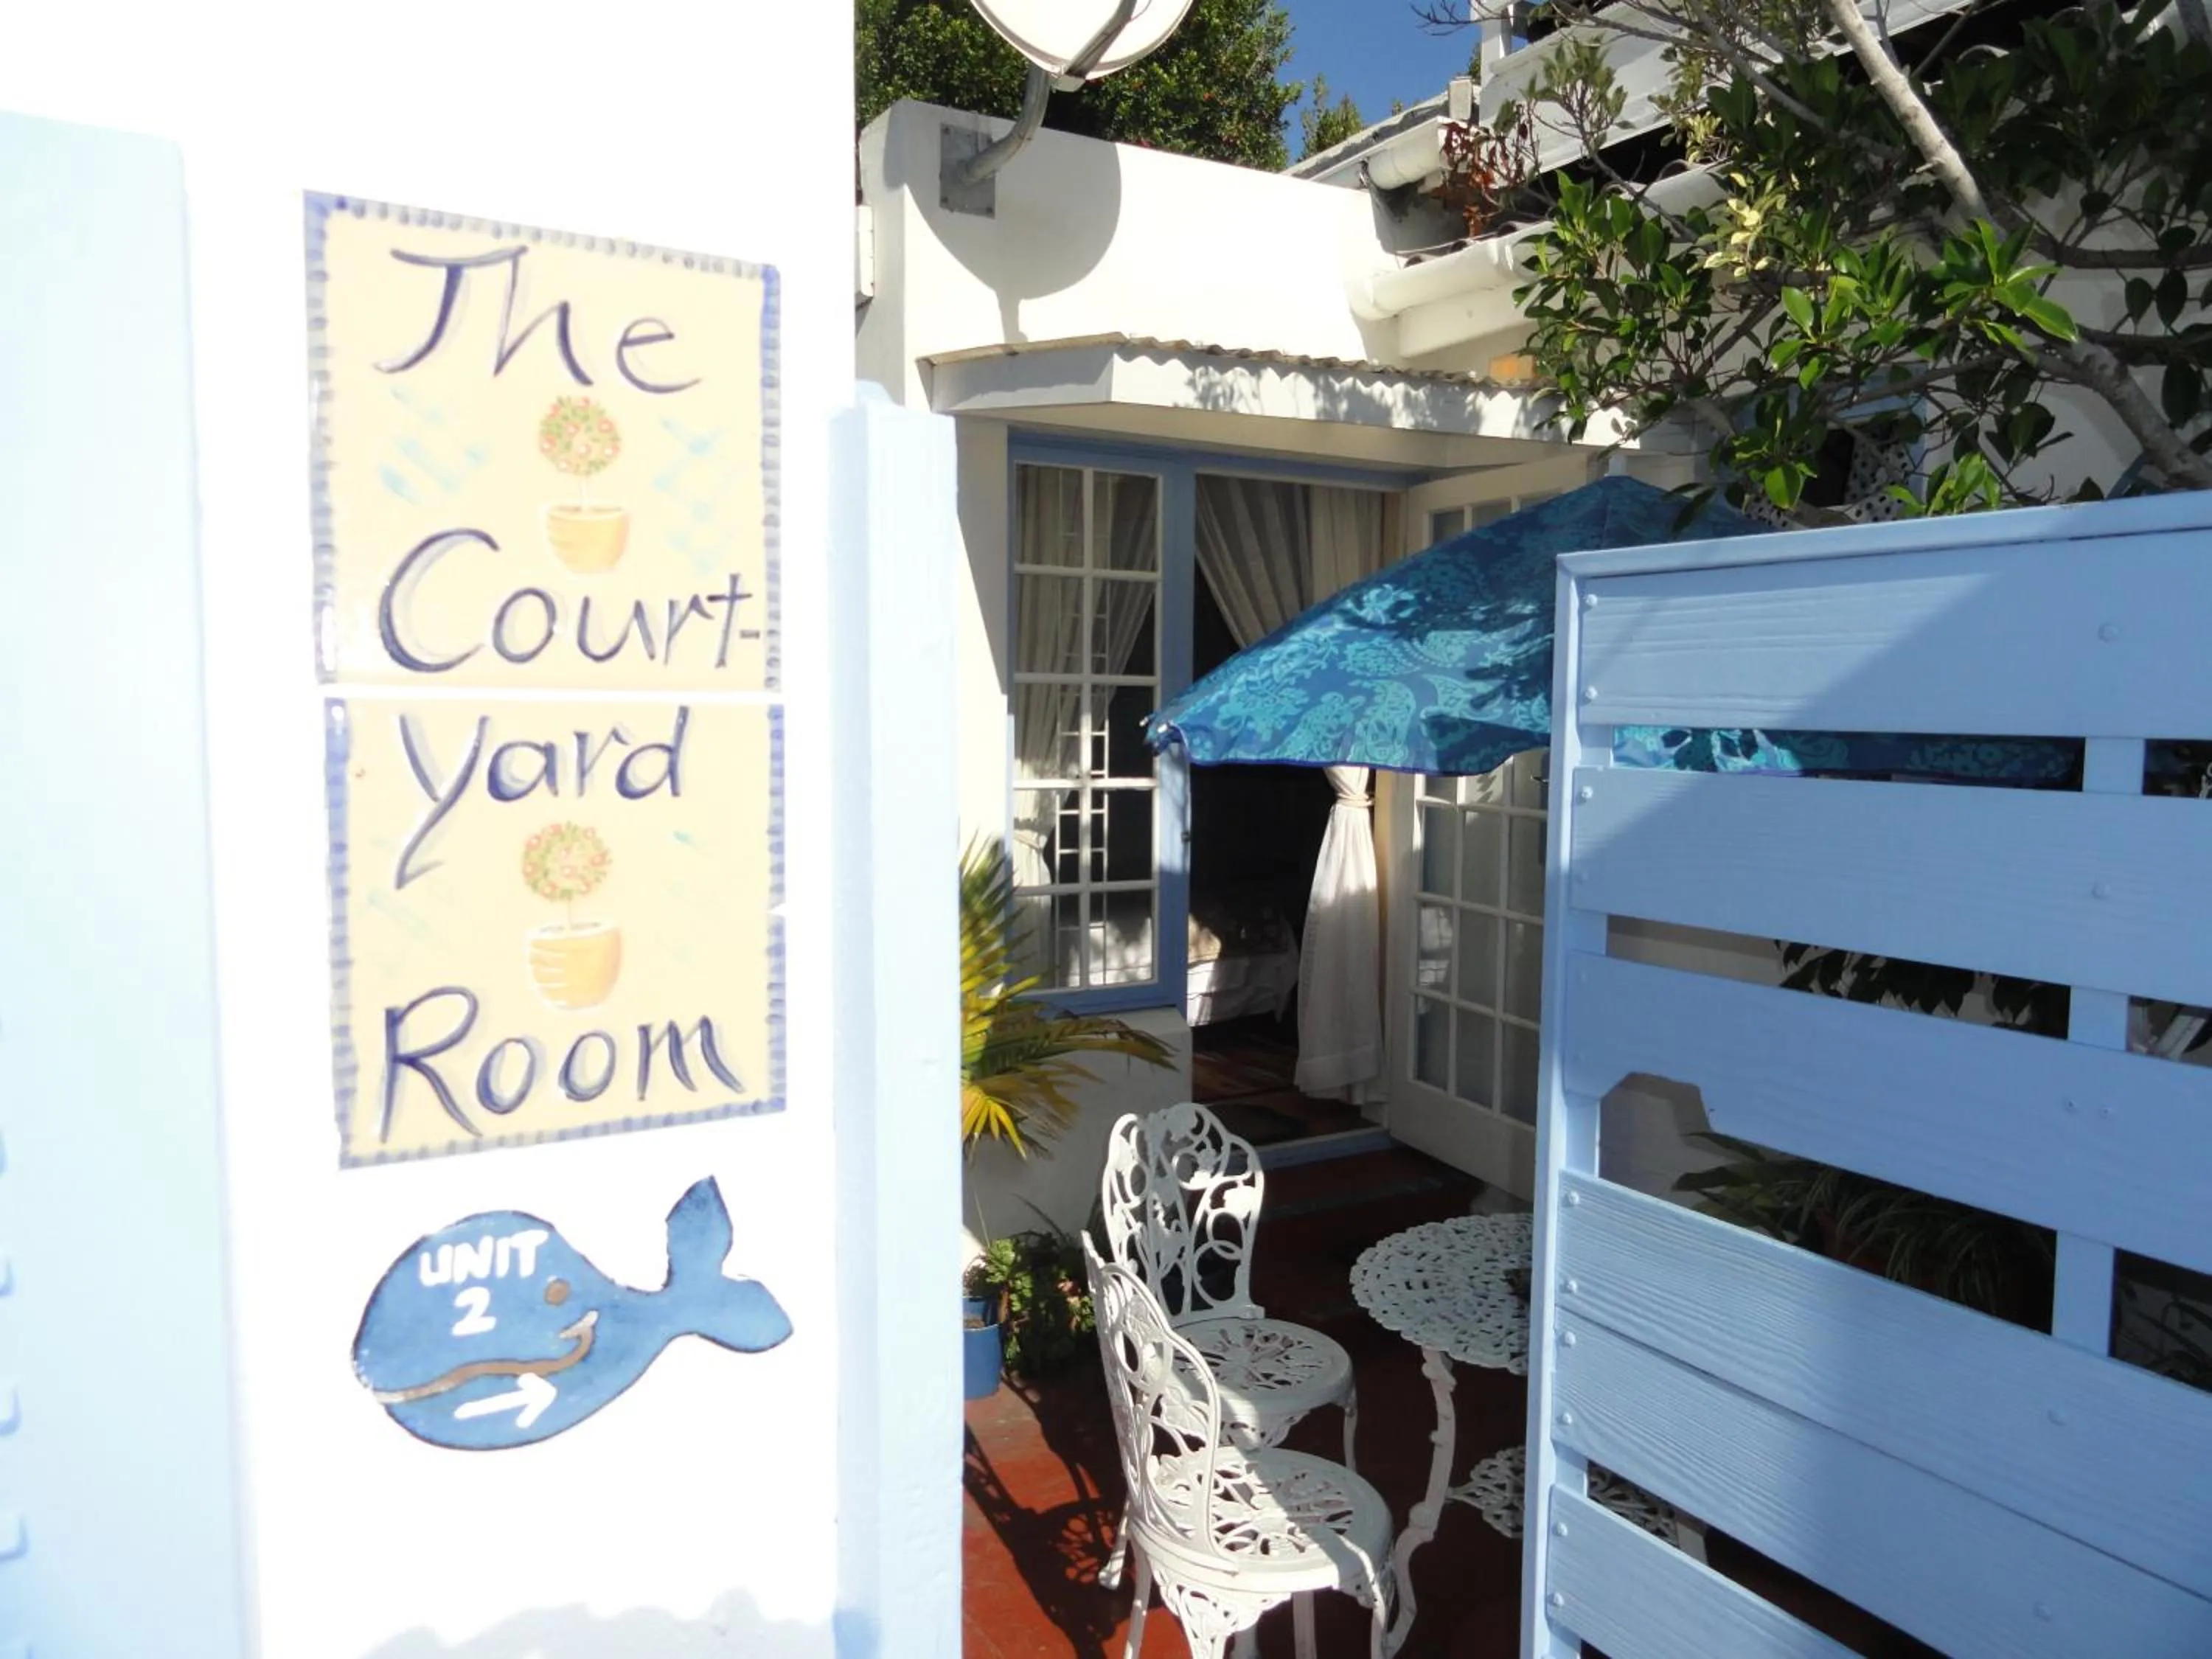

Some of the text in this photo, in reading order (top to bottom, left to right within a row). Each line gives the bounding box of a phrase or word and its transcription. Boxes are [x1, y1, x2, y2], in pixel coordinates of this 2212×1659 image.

[374, 245, 703, 394] The
[378, 527, 761, 673] Court-
[379, 984, 748, 1144] Room
[418, 1229, 549, 1287] UNIT
[450, 1286, 496, 1337] 2
